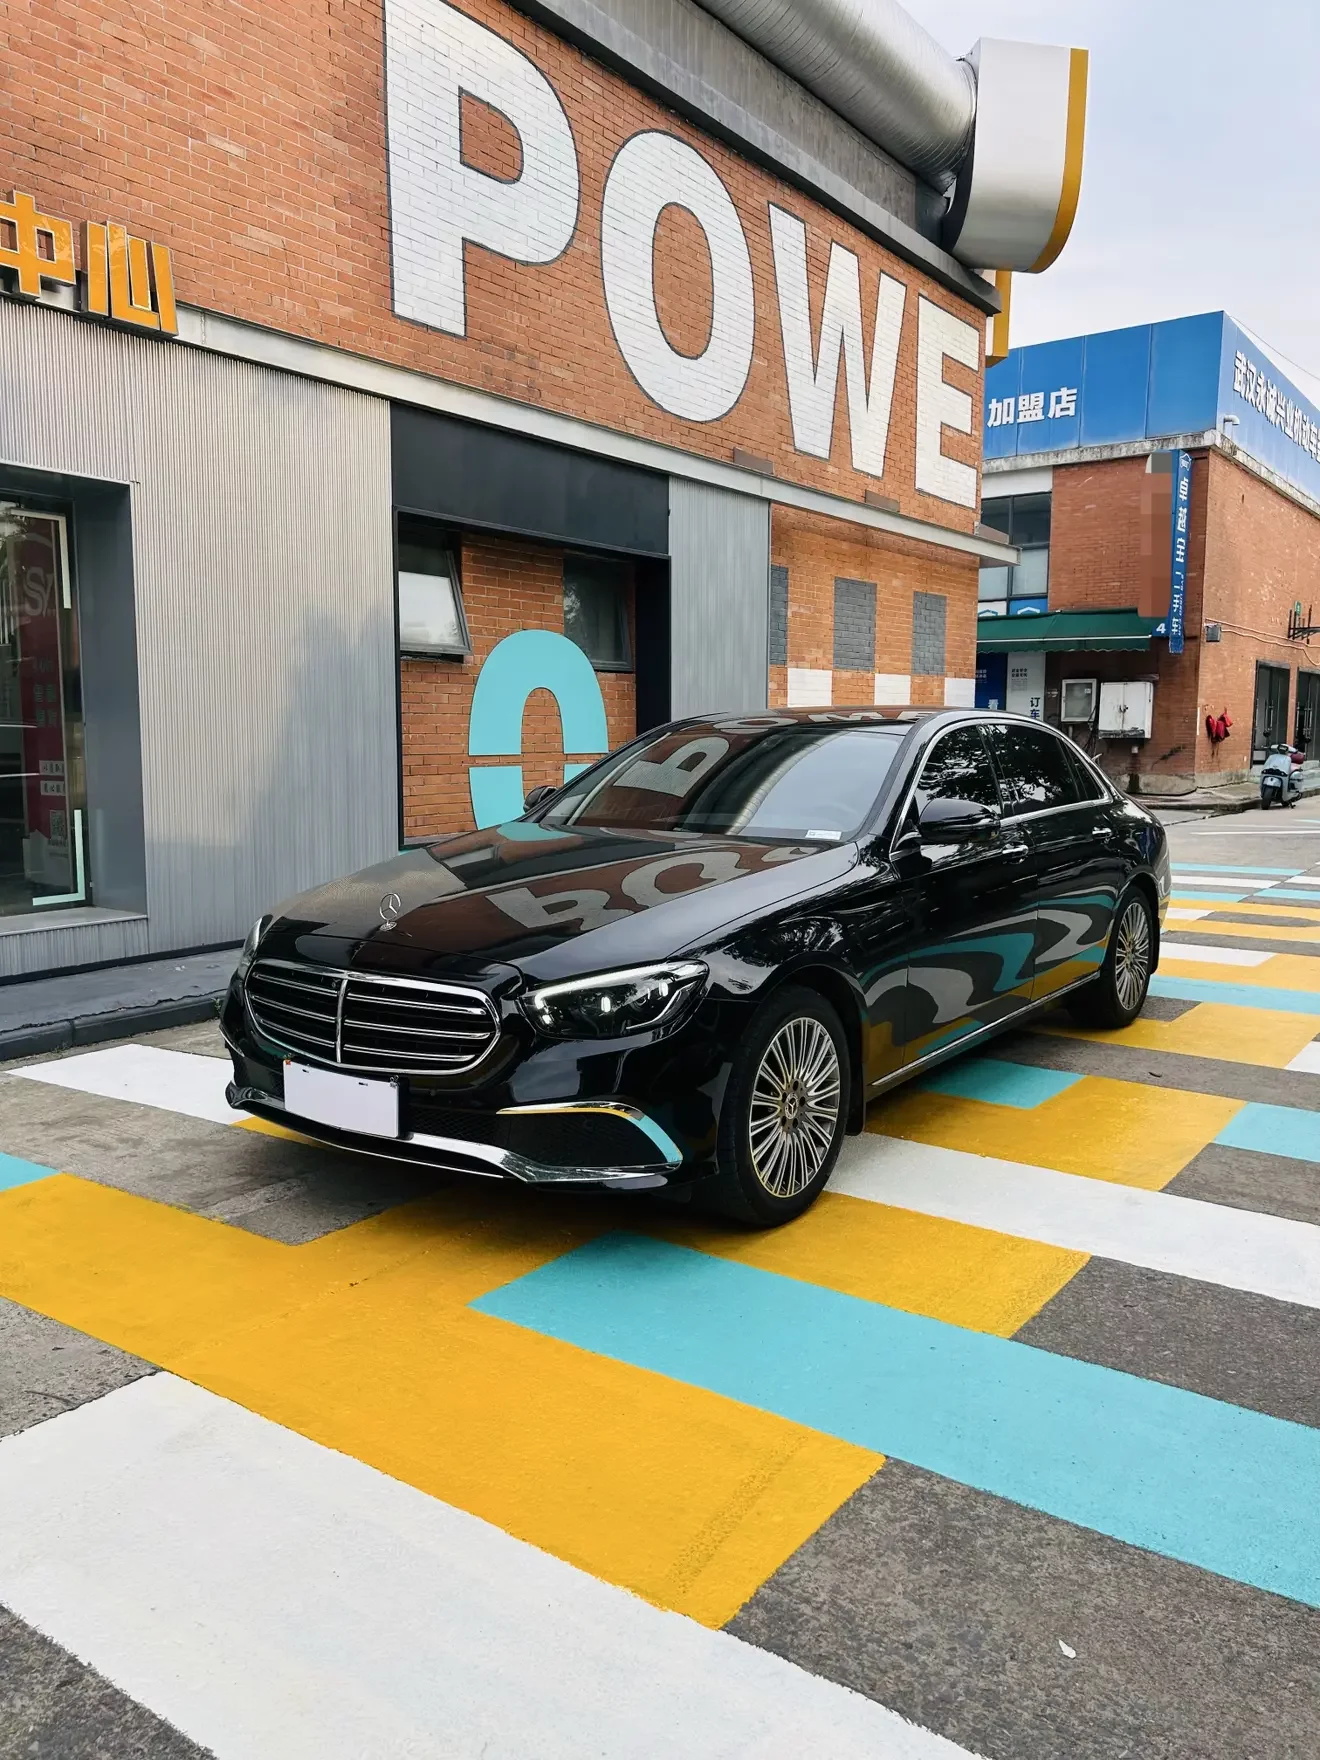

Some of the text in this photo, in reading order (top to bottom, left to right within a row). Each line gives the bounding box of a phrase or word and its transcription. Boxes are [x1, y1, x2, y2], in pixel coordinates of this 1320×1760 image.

[0, 190, 179, 336] 中心
[383, 0, 980, 510] POWE
[987, 386, 1078, 428] 加盟店
